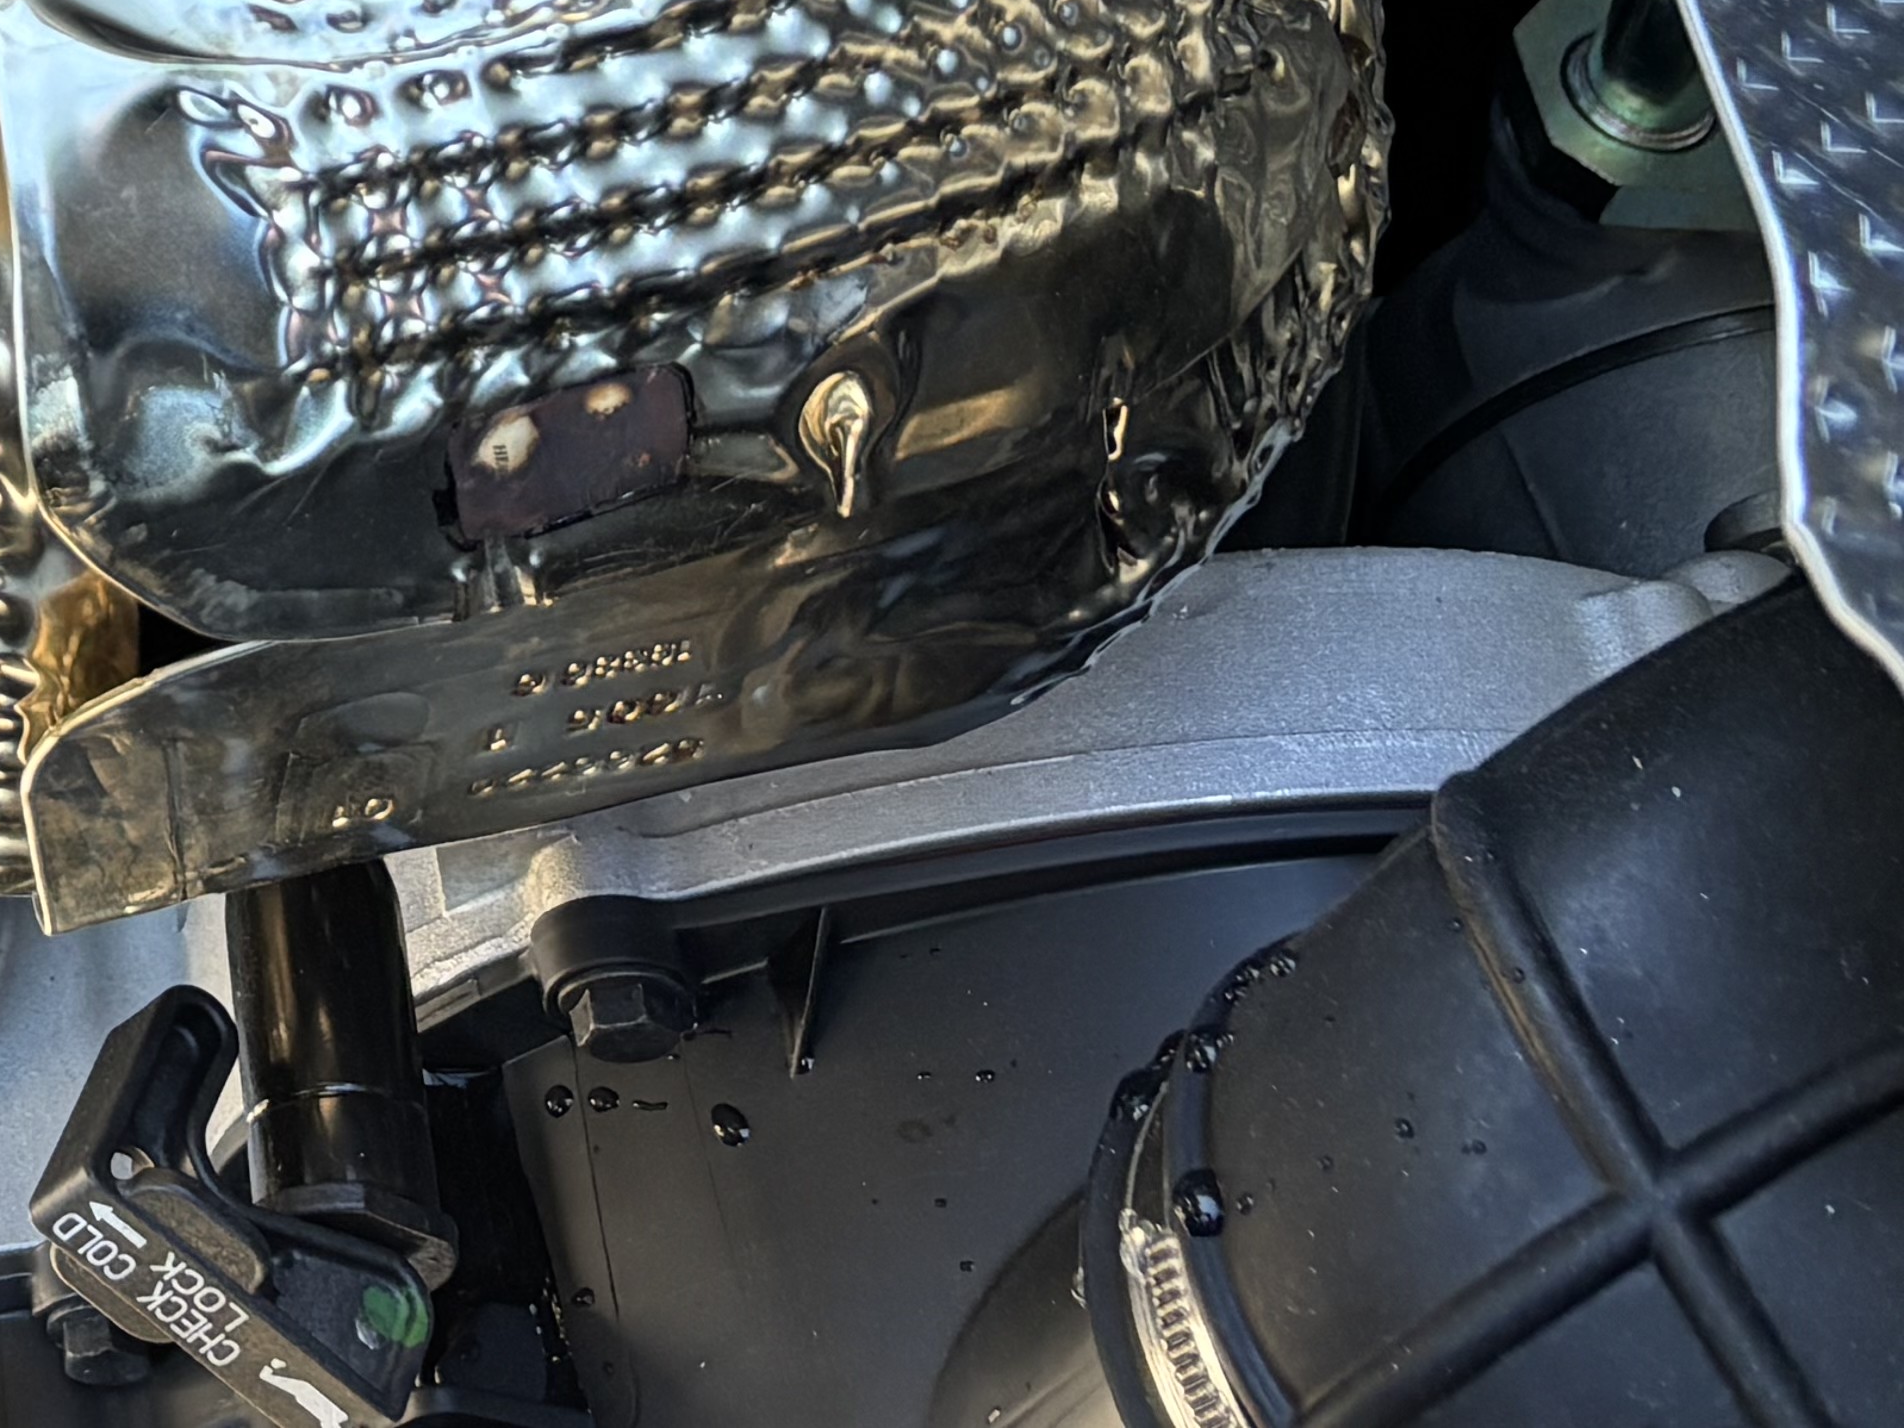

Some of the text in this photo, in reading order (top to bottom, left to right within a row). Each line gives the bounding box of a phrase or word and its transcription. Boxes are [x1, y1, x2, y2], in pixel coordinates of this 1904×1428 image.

[51, 1212, 242, 1367] CHECK COLD
[149, 1251, 250, 1333] LOCK
